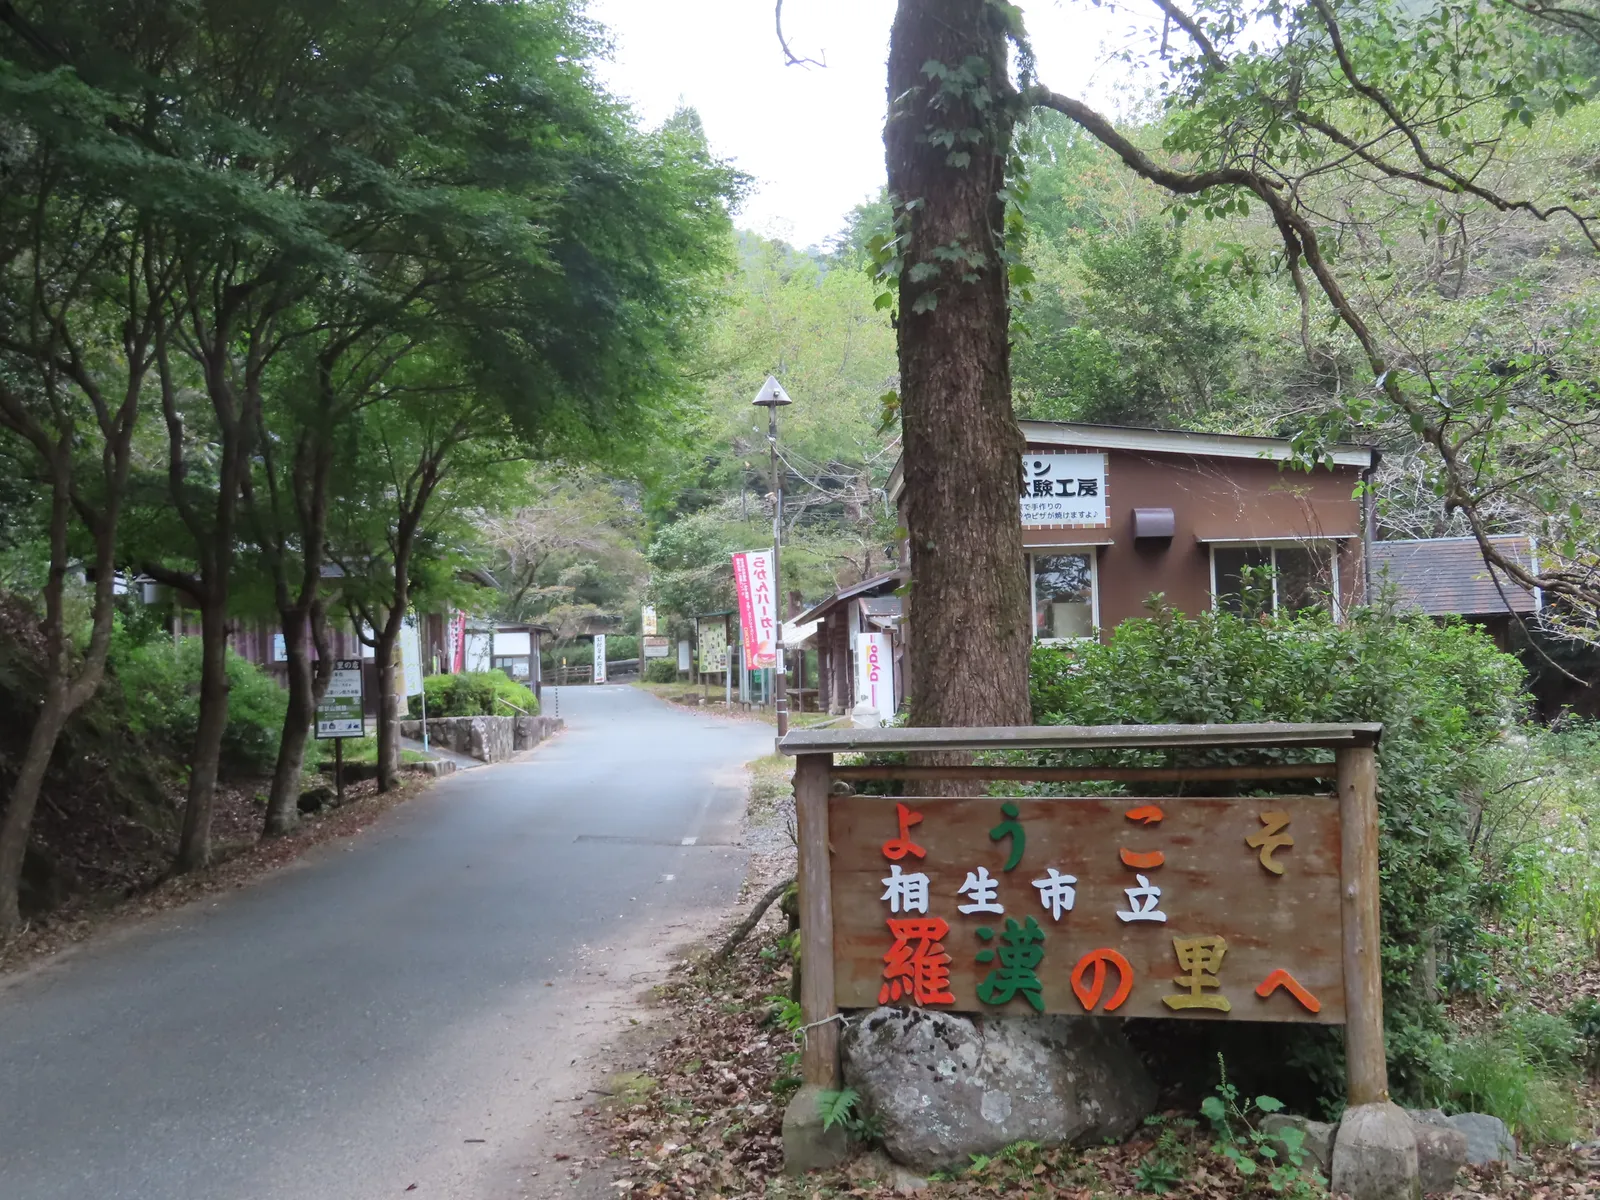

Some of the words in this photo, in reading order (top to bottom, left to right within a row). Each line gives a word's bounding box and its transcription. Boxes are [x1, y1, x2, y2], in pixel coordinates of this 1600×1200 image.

[869, 645, 881, 682] DyDo
[881, 802, 1295, 875] ようこそ
[880, 864, 1168, 924] 相生市立
[877, 914, 1321, 1014] 羅漢の里へ
